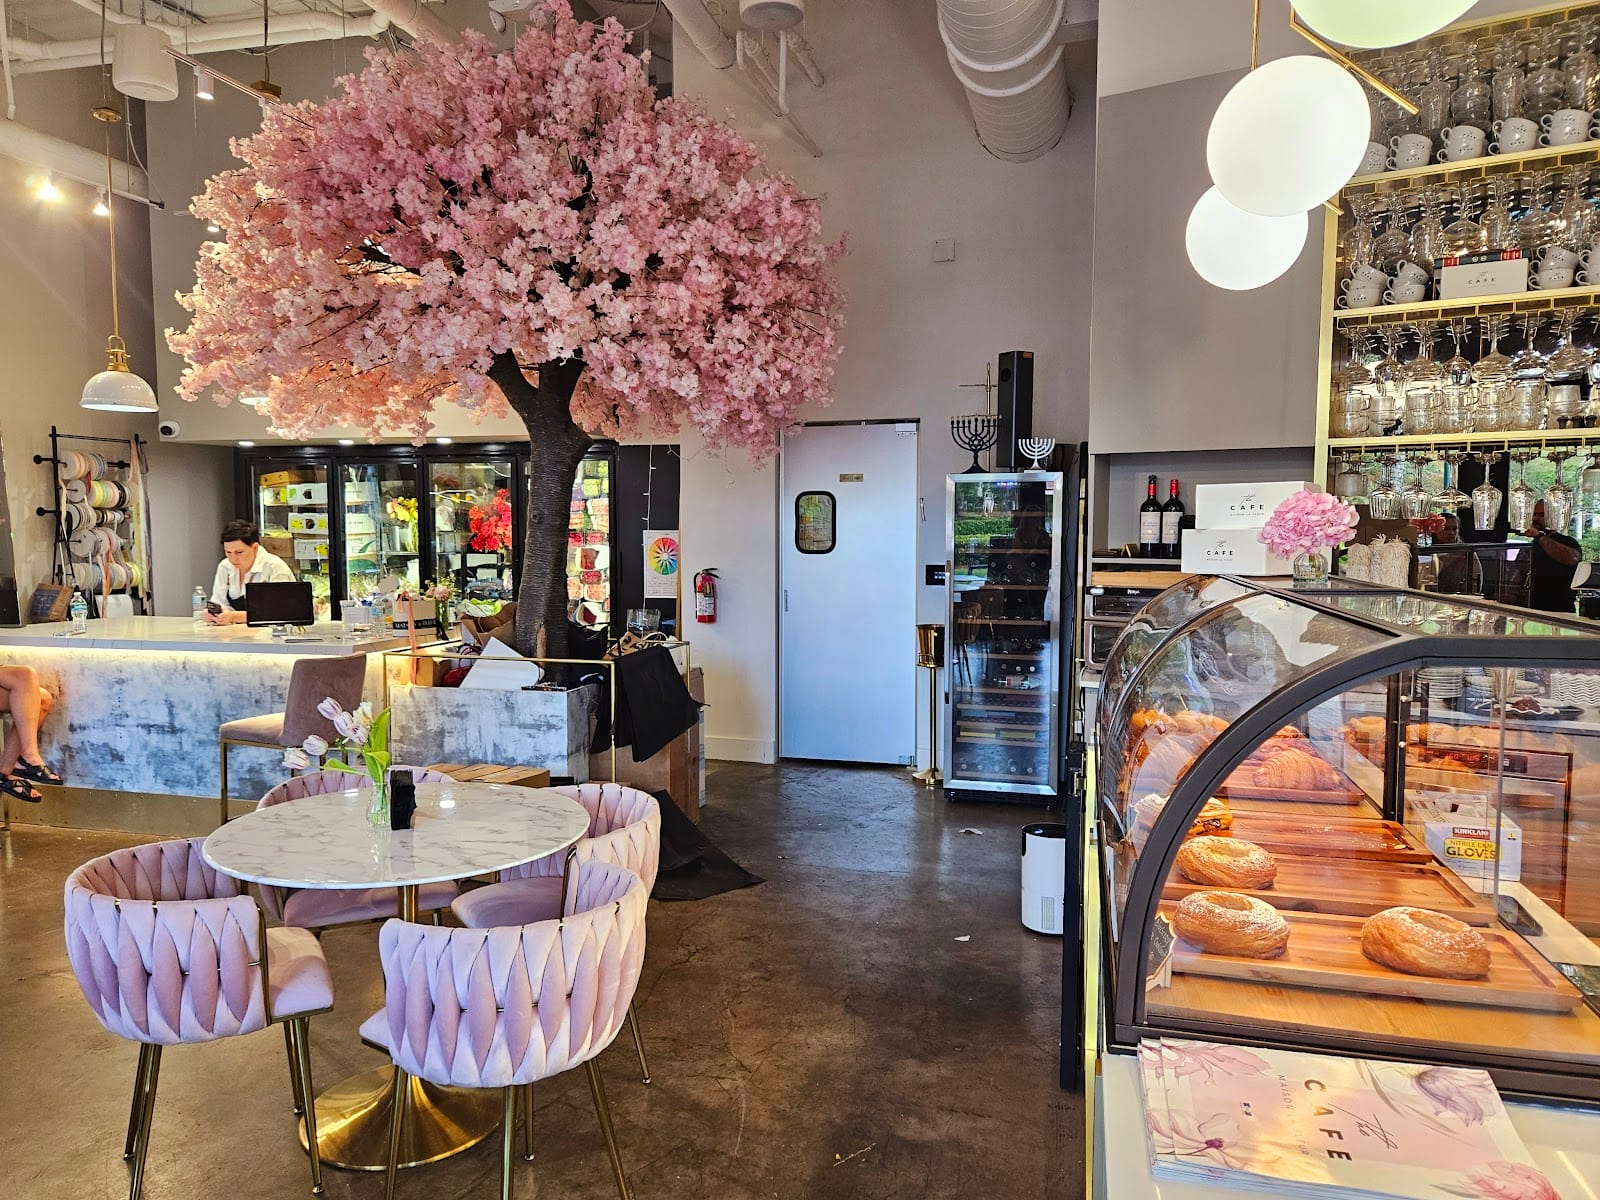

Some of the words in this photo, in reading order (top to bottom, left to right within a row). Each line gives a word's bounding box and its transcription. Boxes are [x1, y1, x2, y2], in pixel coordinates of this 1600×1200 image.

[1446, 846, 1496, 859] GLOVES
[1450, 840, 1476, 848] NITRILE
[1278, 1074, 1294, 1110] MAISON
[1304, 1079, 1352, 1161] CAFE
[1328, 1103, 1399, 1149] The
